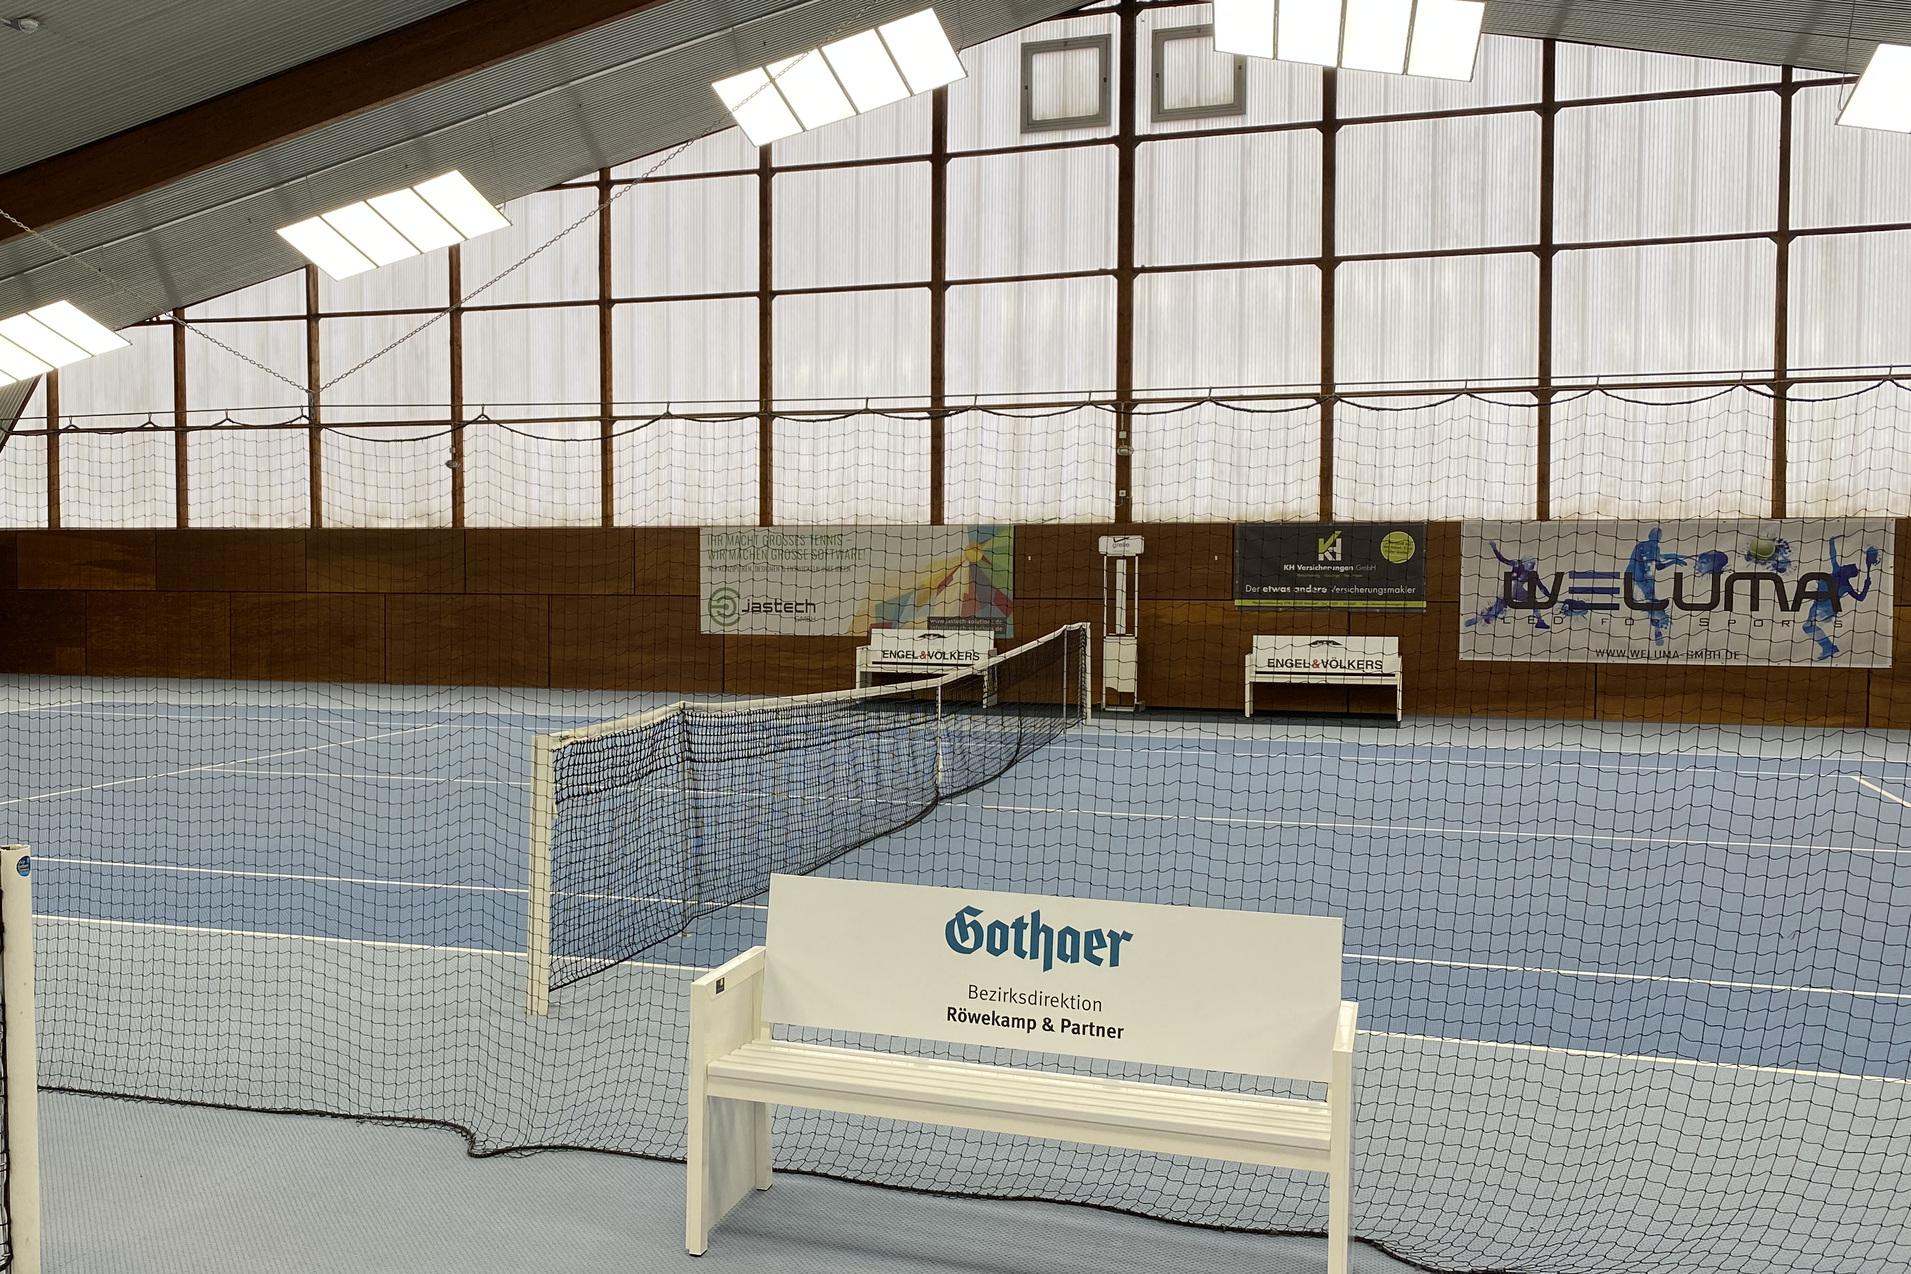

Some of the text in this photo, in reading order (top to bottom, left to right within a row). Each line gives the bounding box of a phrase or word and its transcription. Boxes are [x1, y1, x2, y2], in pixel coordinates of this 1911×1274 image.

[707, 534, 723, 546] IHR
[727, 534, 759, 546] MACHT
[762, 534, 806, 546] GROSSES
[810, 535, 843, 546] TENNIS
[707, 548, 726, 561] WIR
[728, 548, 769, 561] MACHEN
[771, 548, 808, 561] GROSSE
[1297, 563, 1354, 573] Versicherungen
[1245, 584, 1416, 596] Der etwas andere Versicherungsmakler
[1504, 571, 1842, 612] WELUMA
[741, 598, 816, 613] jastech
[1503, 616, 1564, 626] LED
[1267, 657, 1383, 670] ENGEL&VÖLKERS
[945, 905, 1134, 972] Gothaer
[968, 984, 1102, 1012] Bezirksdirektion
[946, 1006, 1124, 1039] Röwekamp & Partner
